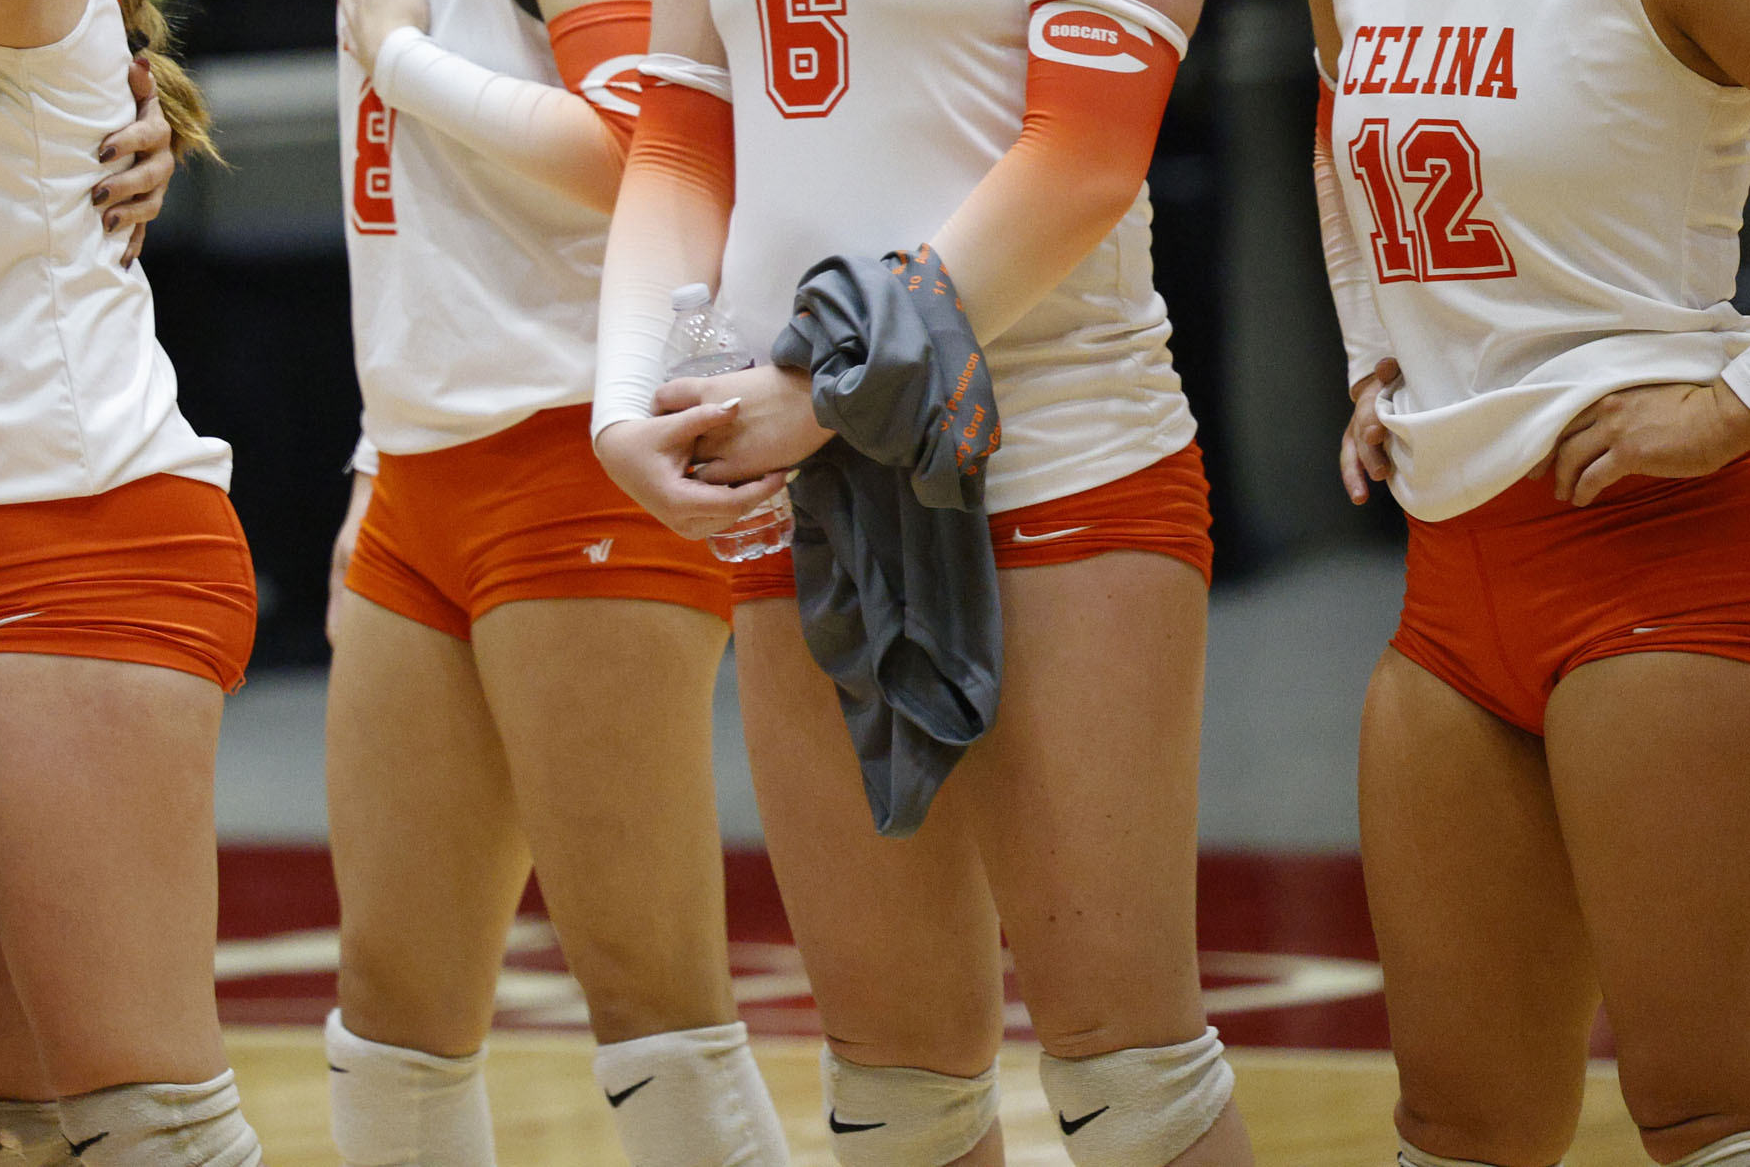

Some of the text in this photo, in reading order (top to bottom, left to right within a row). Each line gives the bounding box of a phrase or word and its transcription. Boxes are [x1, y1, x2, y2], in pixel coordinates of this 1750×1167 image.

[1049, 24, 1119, 45] BOBCATS
[1342, 25, 1518, 100] CELINA
[1348, 117, 1518, 285] 12
[946, 352, 981, 411] Paulson
[962, 403, 986, 440] Graf
